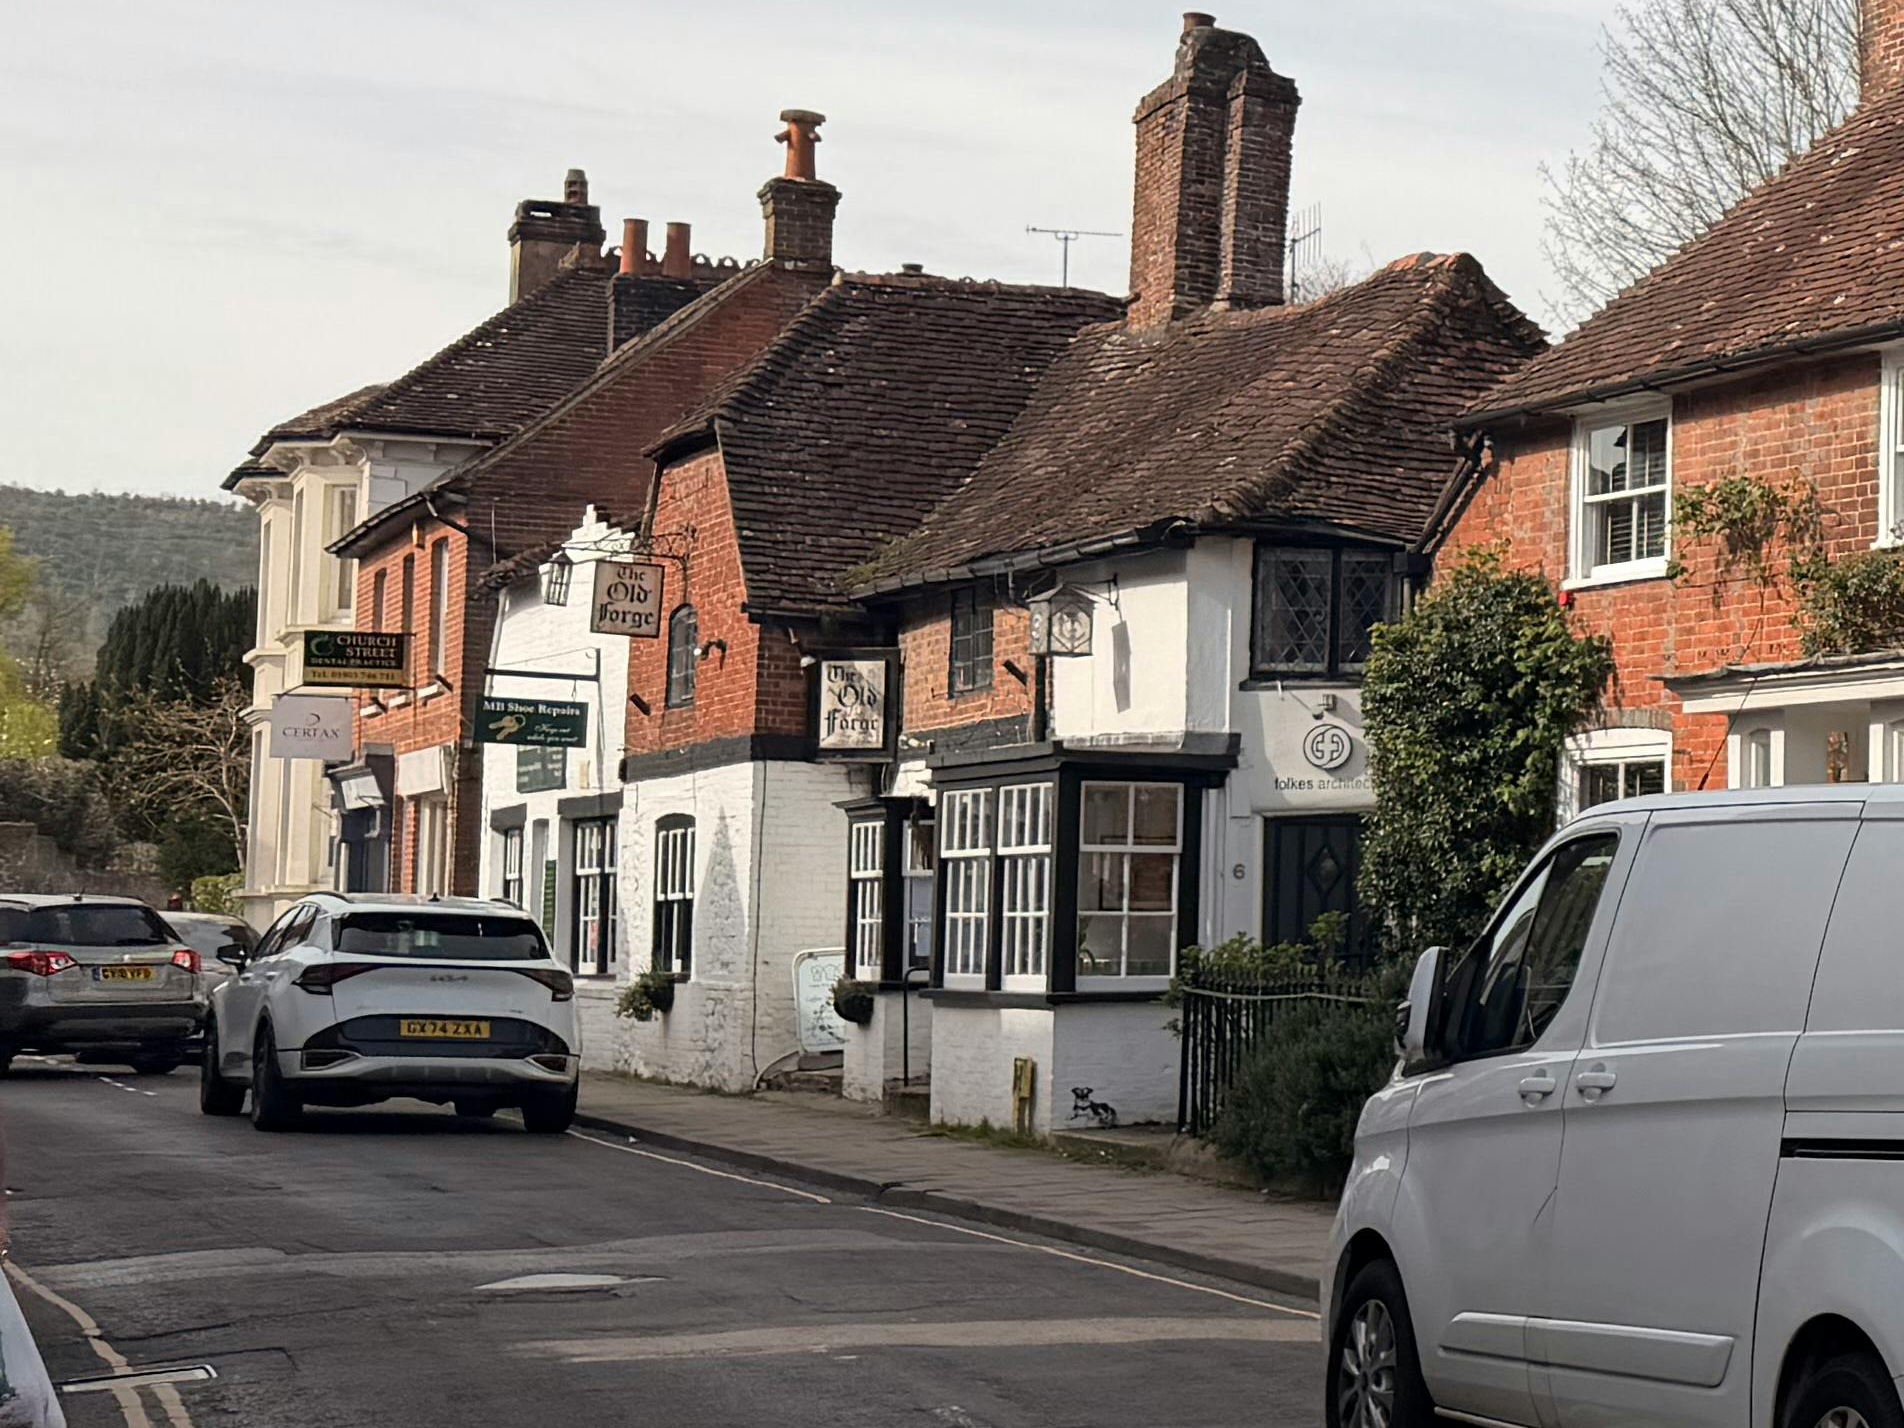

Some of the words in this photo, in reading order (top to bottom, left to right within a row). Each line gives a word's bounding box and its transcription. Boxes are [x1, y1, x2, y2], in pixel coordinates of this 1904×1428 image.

[617, 566, 646, 581] The
[607, 581, 652, 603] Old
[599, 601, 655, 628] Forge
[336, 635, 397, 647] CHURCH
[345, 647, 397, 658] STREET
[310, 657, 347, 665] DENTAL
[349, 658, 397, 667] PRACTICE
[827, 664, 857, 683] The
[830, 684, 877, 708] Old
[507, 702, 535, 712] Shoe
[538, 704, 580, 716] Repairs
[821, 708, 879, 740] Forge
[282, 726, 340, 739] CERTAX
[1274, 777, 1314, 790] folkes
[1317, 777, 1372, 790] architec
[1233, 863, 1246, 880] 6
